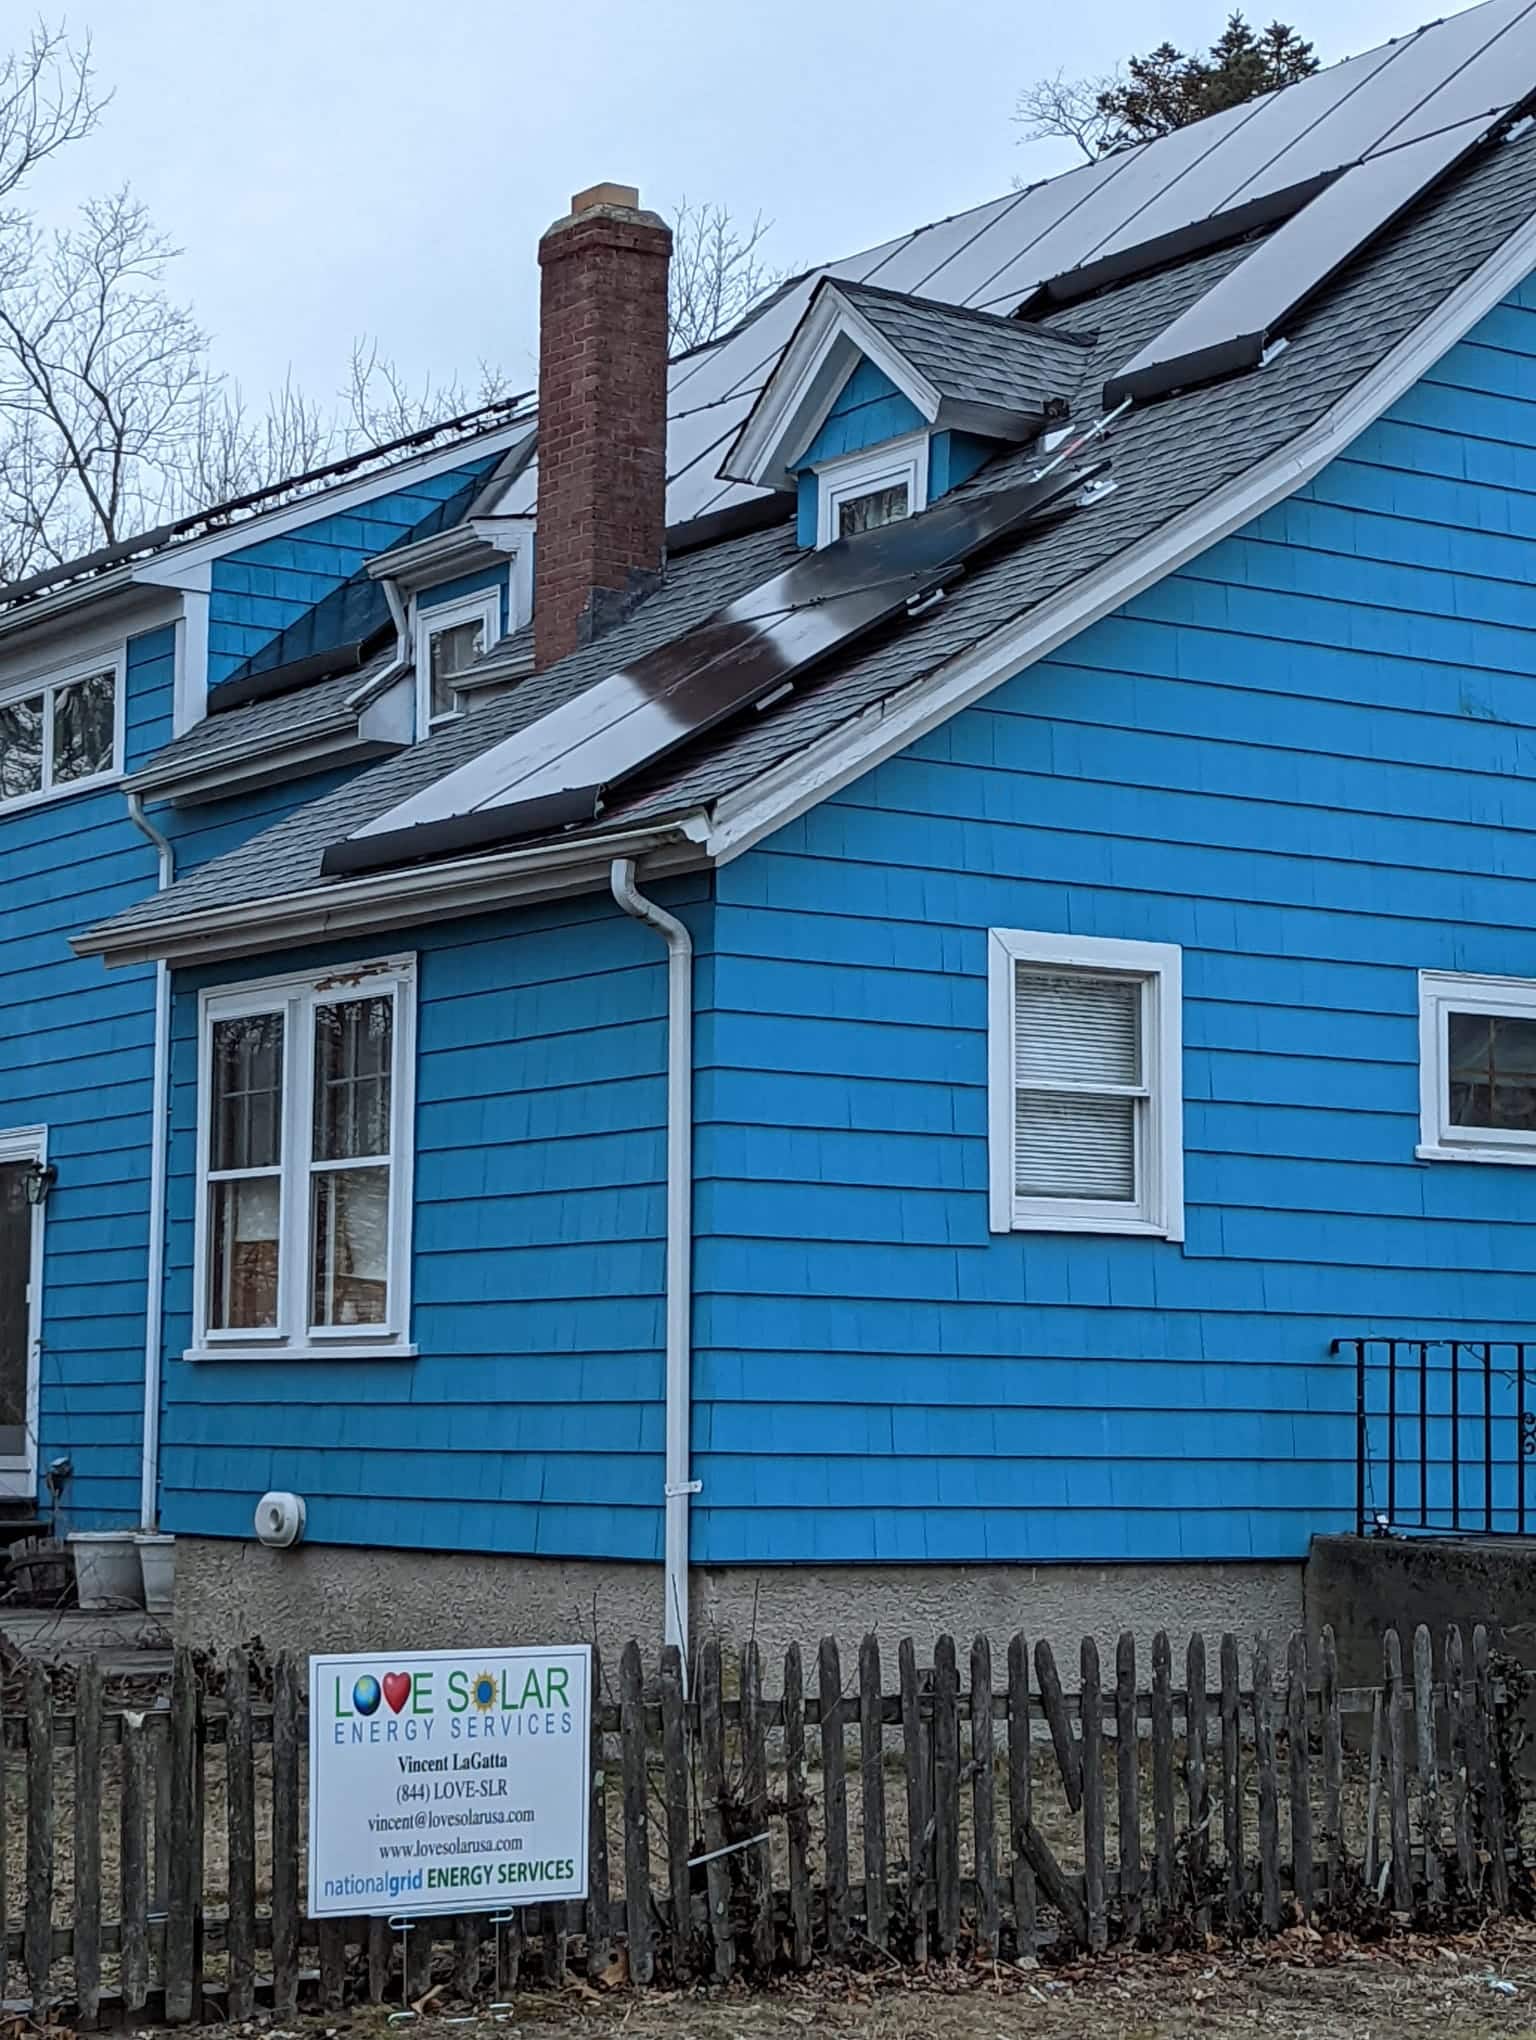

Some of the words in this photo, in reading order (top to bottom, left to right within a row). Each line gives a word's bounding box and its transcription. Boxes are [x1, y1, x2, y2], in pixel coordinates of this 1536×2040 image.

[335, 1719, 434, 1744] ENERGY
[450, 1712, 572, 1739] SERVICES
[398, 1754, 448, 1774] Vincent
[452, 1752, 508, 1771] LaGatta
[396, 1783, 430, 1804] (844)
[434, 1779, 508, 1800] LOVE-SLR
[368, 1808, 535, 1832] vincent@lovesolarusa.com
[379, 1836, 523, 1859] www.lovesolarusa.com
[324, 1869, 423, 1896] nationalgrid
[427, 1865, 493, 1889] ENERGY
[497, 1859, 574, 1884] SERVICES
